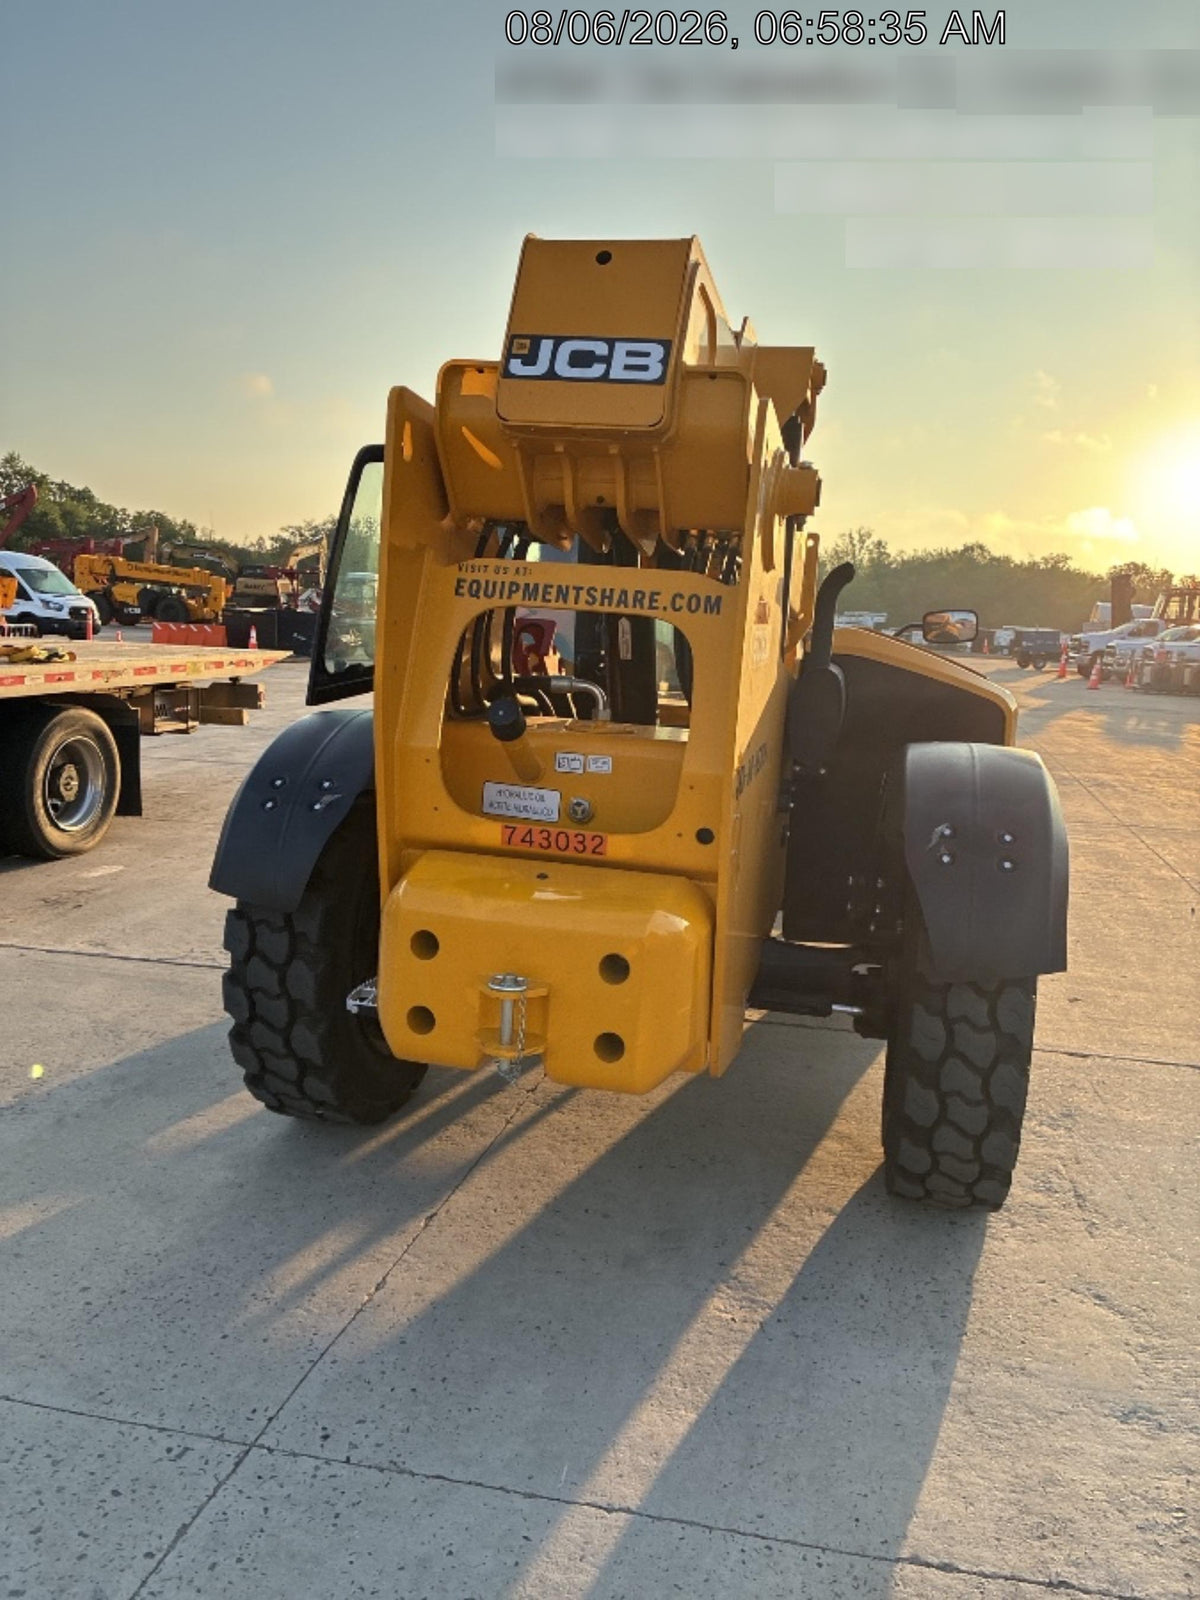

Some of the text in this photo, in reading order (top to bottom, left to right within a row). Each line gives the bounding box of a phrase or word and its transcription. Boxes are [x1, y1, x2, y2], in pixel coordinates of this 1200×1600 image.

[508, 338, 665, 381] JCB
[457, 562, 489, 574] VISIT
[454, 577, 722, 615] EQUIPMENTSHARE.COM
[504, 825, 605, 855] 743032
